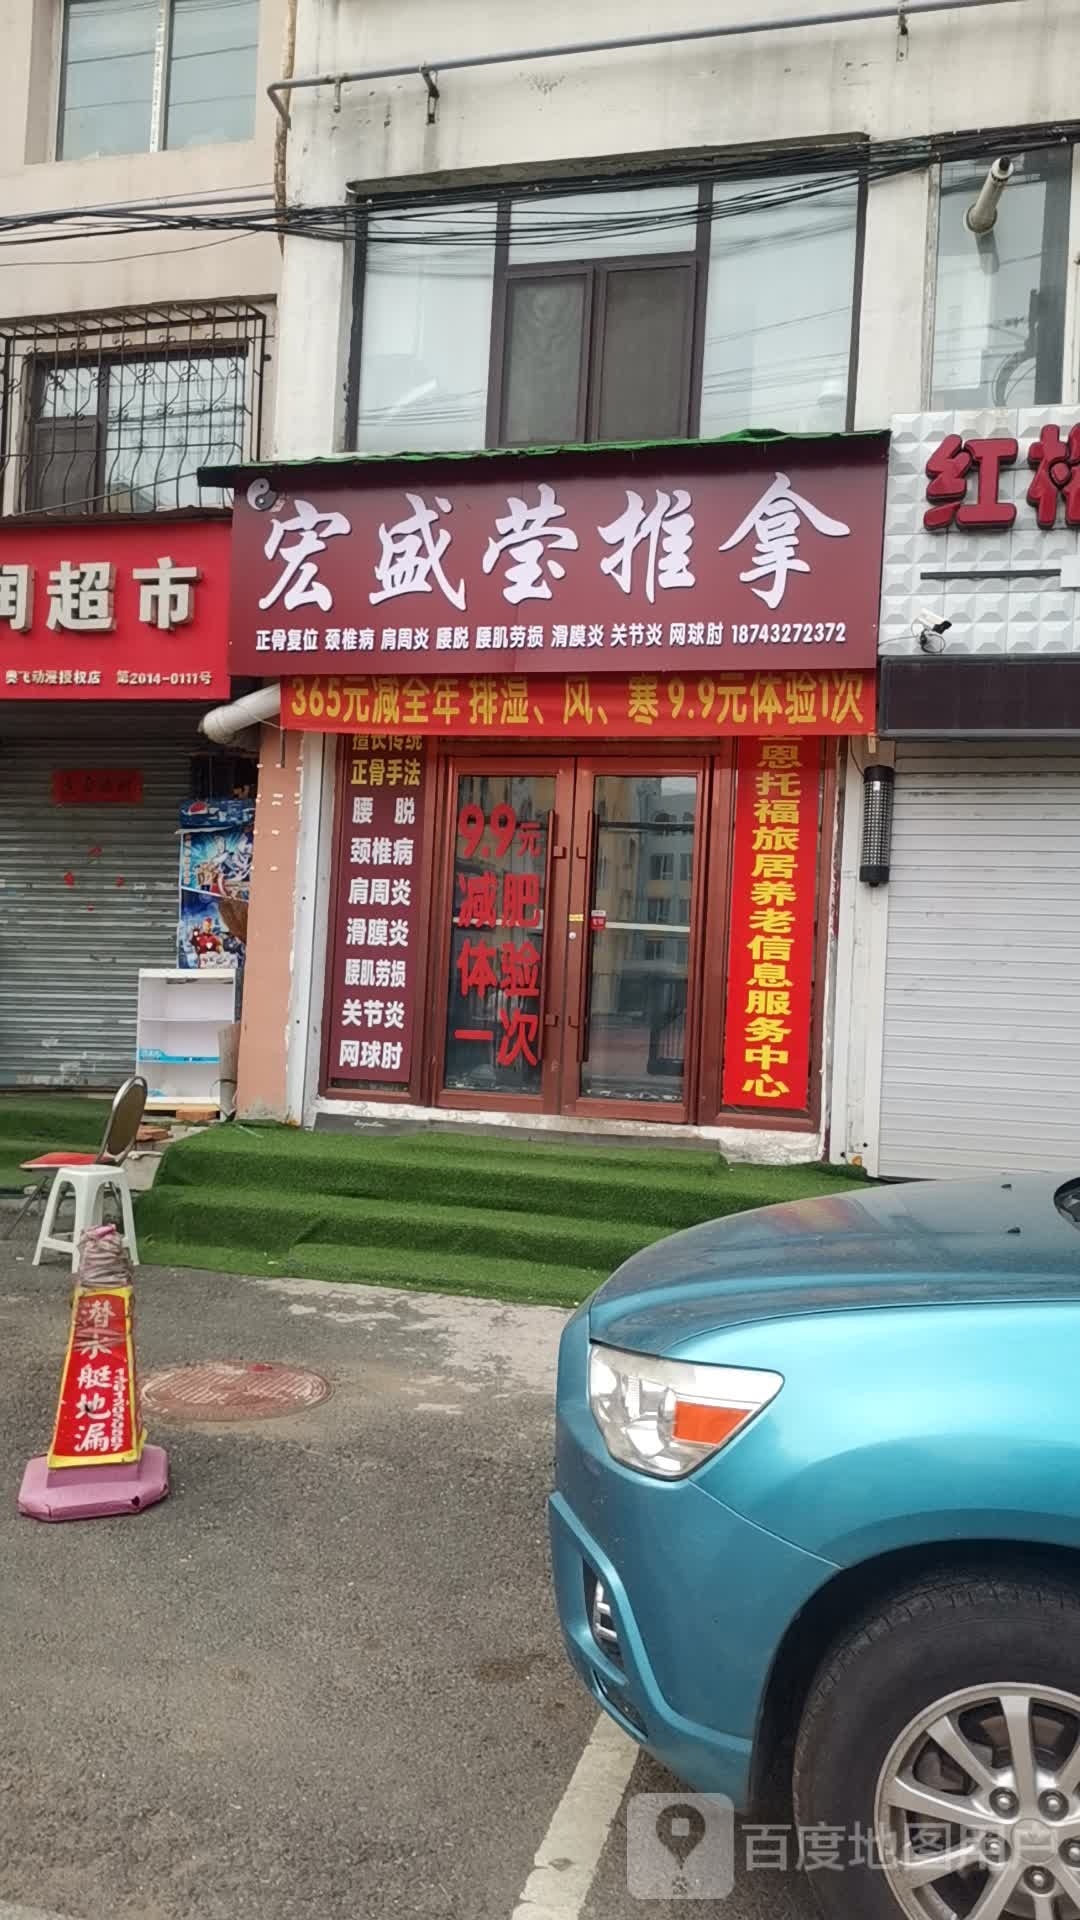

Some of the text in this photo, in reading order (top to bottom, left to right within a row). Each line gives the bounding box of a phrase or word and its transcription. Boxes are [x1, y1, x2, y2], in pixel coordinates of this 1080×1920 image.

[257, 473, 850, 611] 宏盛莹推拿
[255, 621, 847, 652] 正骨复位 颈椎病 肩周炎 腰脱 腰肌劳损 滑膜炎 关节炎 网球肘 18743272372
[349, 758, 421, 787] 正骨手法
[349, 836, 414, 866] 颈椎病
[347, 877, 412, 907] 肩周炎
[456, 871, 540, 929] 减肥
[345, 916, 409, 947] 滑膜炎
[742, 736, 802, 1098] 恩托福旅居养老信息服务中心
[343, 957, 406, 988] 腰肌劳损
[456, 938, 541, 998] 体验
[341, 998, 405, 1029] 关节炎
[453, 1008, 539, 1067] 一次
[339, 1039, 404, 1070] 网球肘
